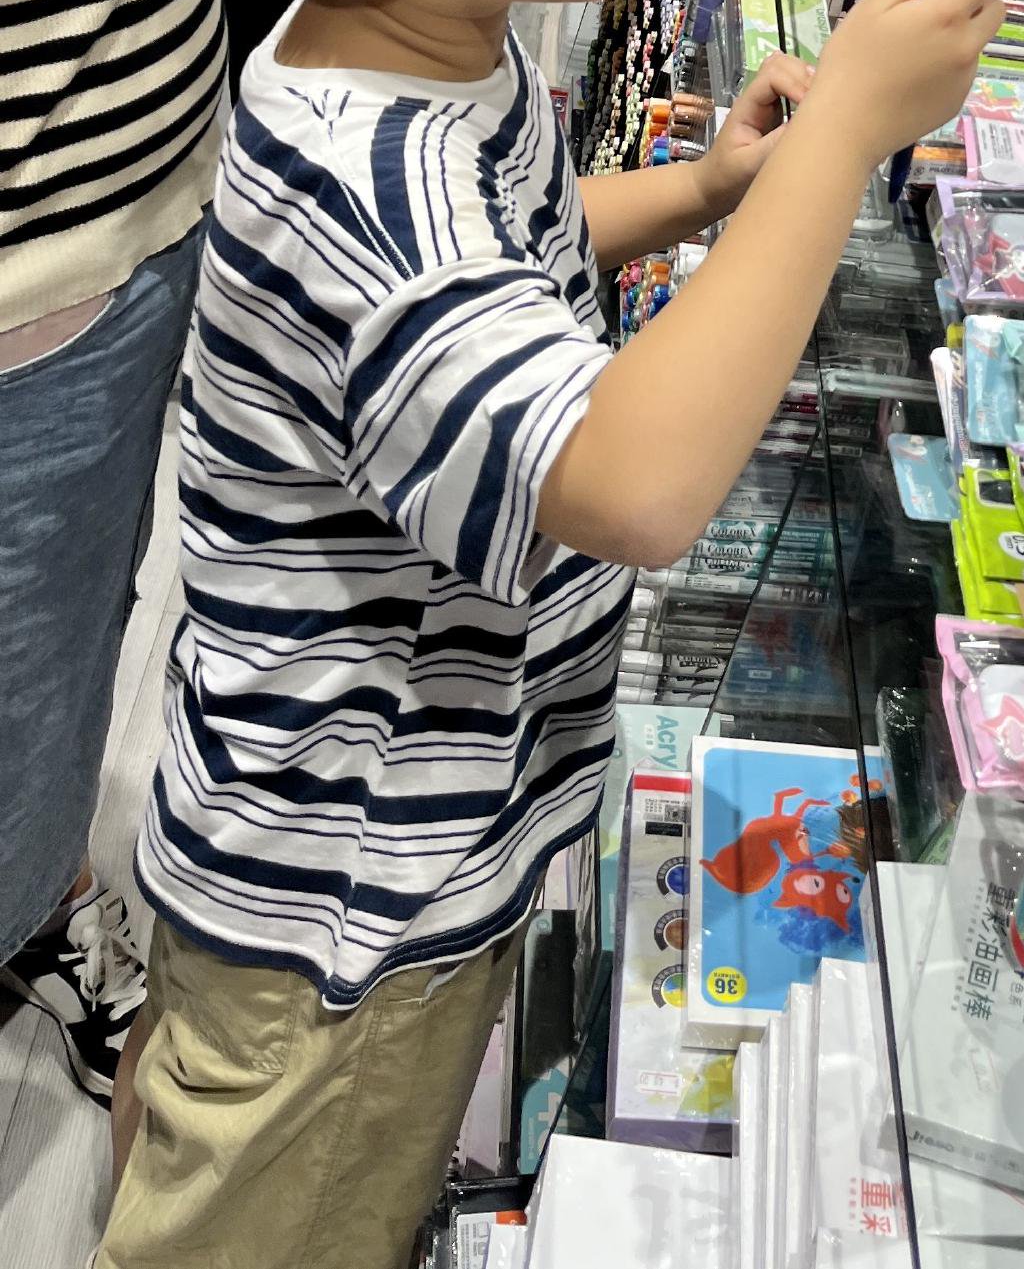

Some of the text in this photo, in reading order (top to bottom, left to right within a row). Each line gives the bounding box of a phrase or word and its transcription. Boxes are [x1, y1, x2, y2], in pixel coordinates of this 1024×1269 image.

[711, 525, 756, 538] COLOREX
[707, 544, 753, 557] COLOREX
[655, 714, 680, 769] Acry
[962, 881, 1016, 1021] 重彩油画棒
[714, 977, 738, 995] 36
